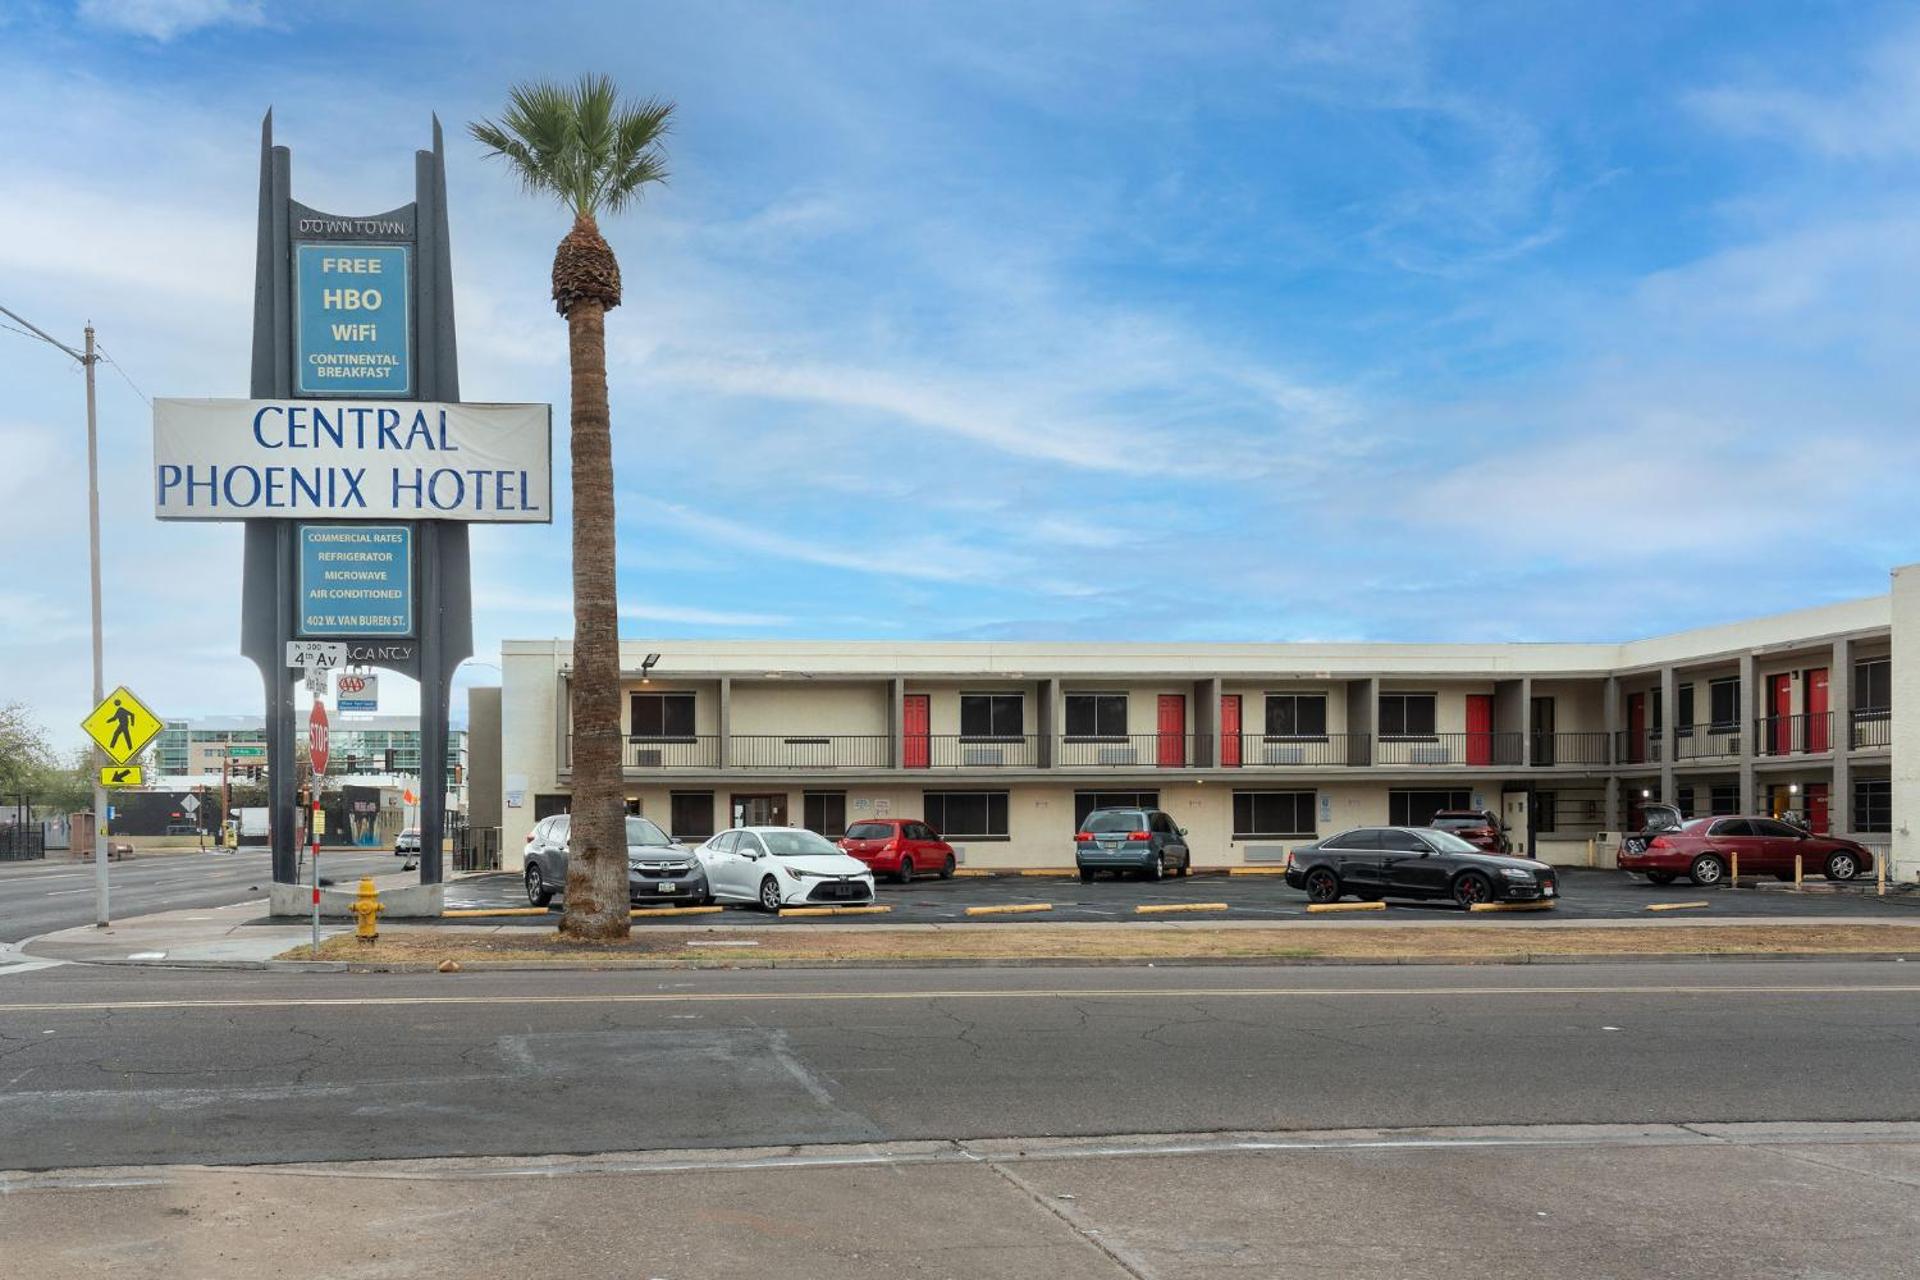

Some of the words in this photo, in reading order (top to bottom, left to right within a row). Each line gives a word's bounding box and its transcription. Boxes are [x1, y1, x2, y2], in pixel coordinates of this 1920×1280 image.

[300, 219, 404, 234] DOWNTOWN
[322, 258, 382, 274] FREE
[323, 288, 382, 310] HBO
[331, 324, 377, 341] WiFi
[309, 354, 400, 366] CONTINENTAL
[317, 367, 392, 378] BREAKFAST
[253, 406, 458, 452] CENTRAL
[157, 464, 368, 509] PHOENIX
[392, 467, 540, 511] HOTEL
[308, 534, 371, 542] COMMERCIAL
[373, 534, 402, 543] RATES
[318, 552, 393, 561] REFRIGERATOR
[325, 571, 387, 580] MICROWAVE
[310, 589, 328, 598] AIR
[329, 589, 402, 599] CONDITIONED
[307, 616, 323, 625] 402
[325, 616, 336, 625] W.
[338, 616, 357, 625] VAN
[360, 616, 391, 625] BUREN
[392, 616, 405, 626] ST.
[295, 652, 314, 666] 4th
[316, 652, 337, 666] Av
[341, 677, 364, 692] AAA
[310, 723, 329, 752] STOP
